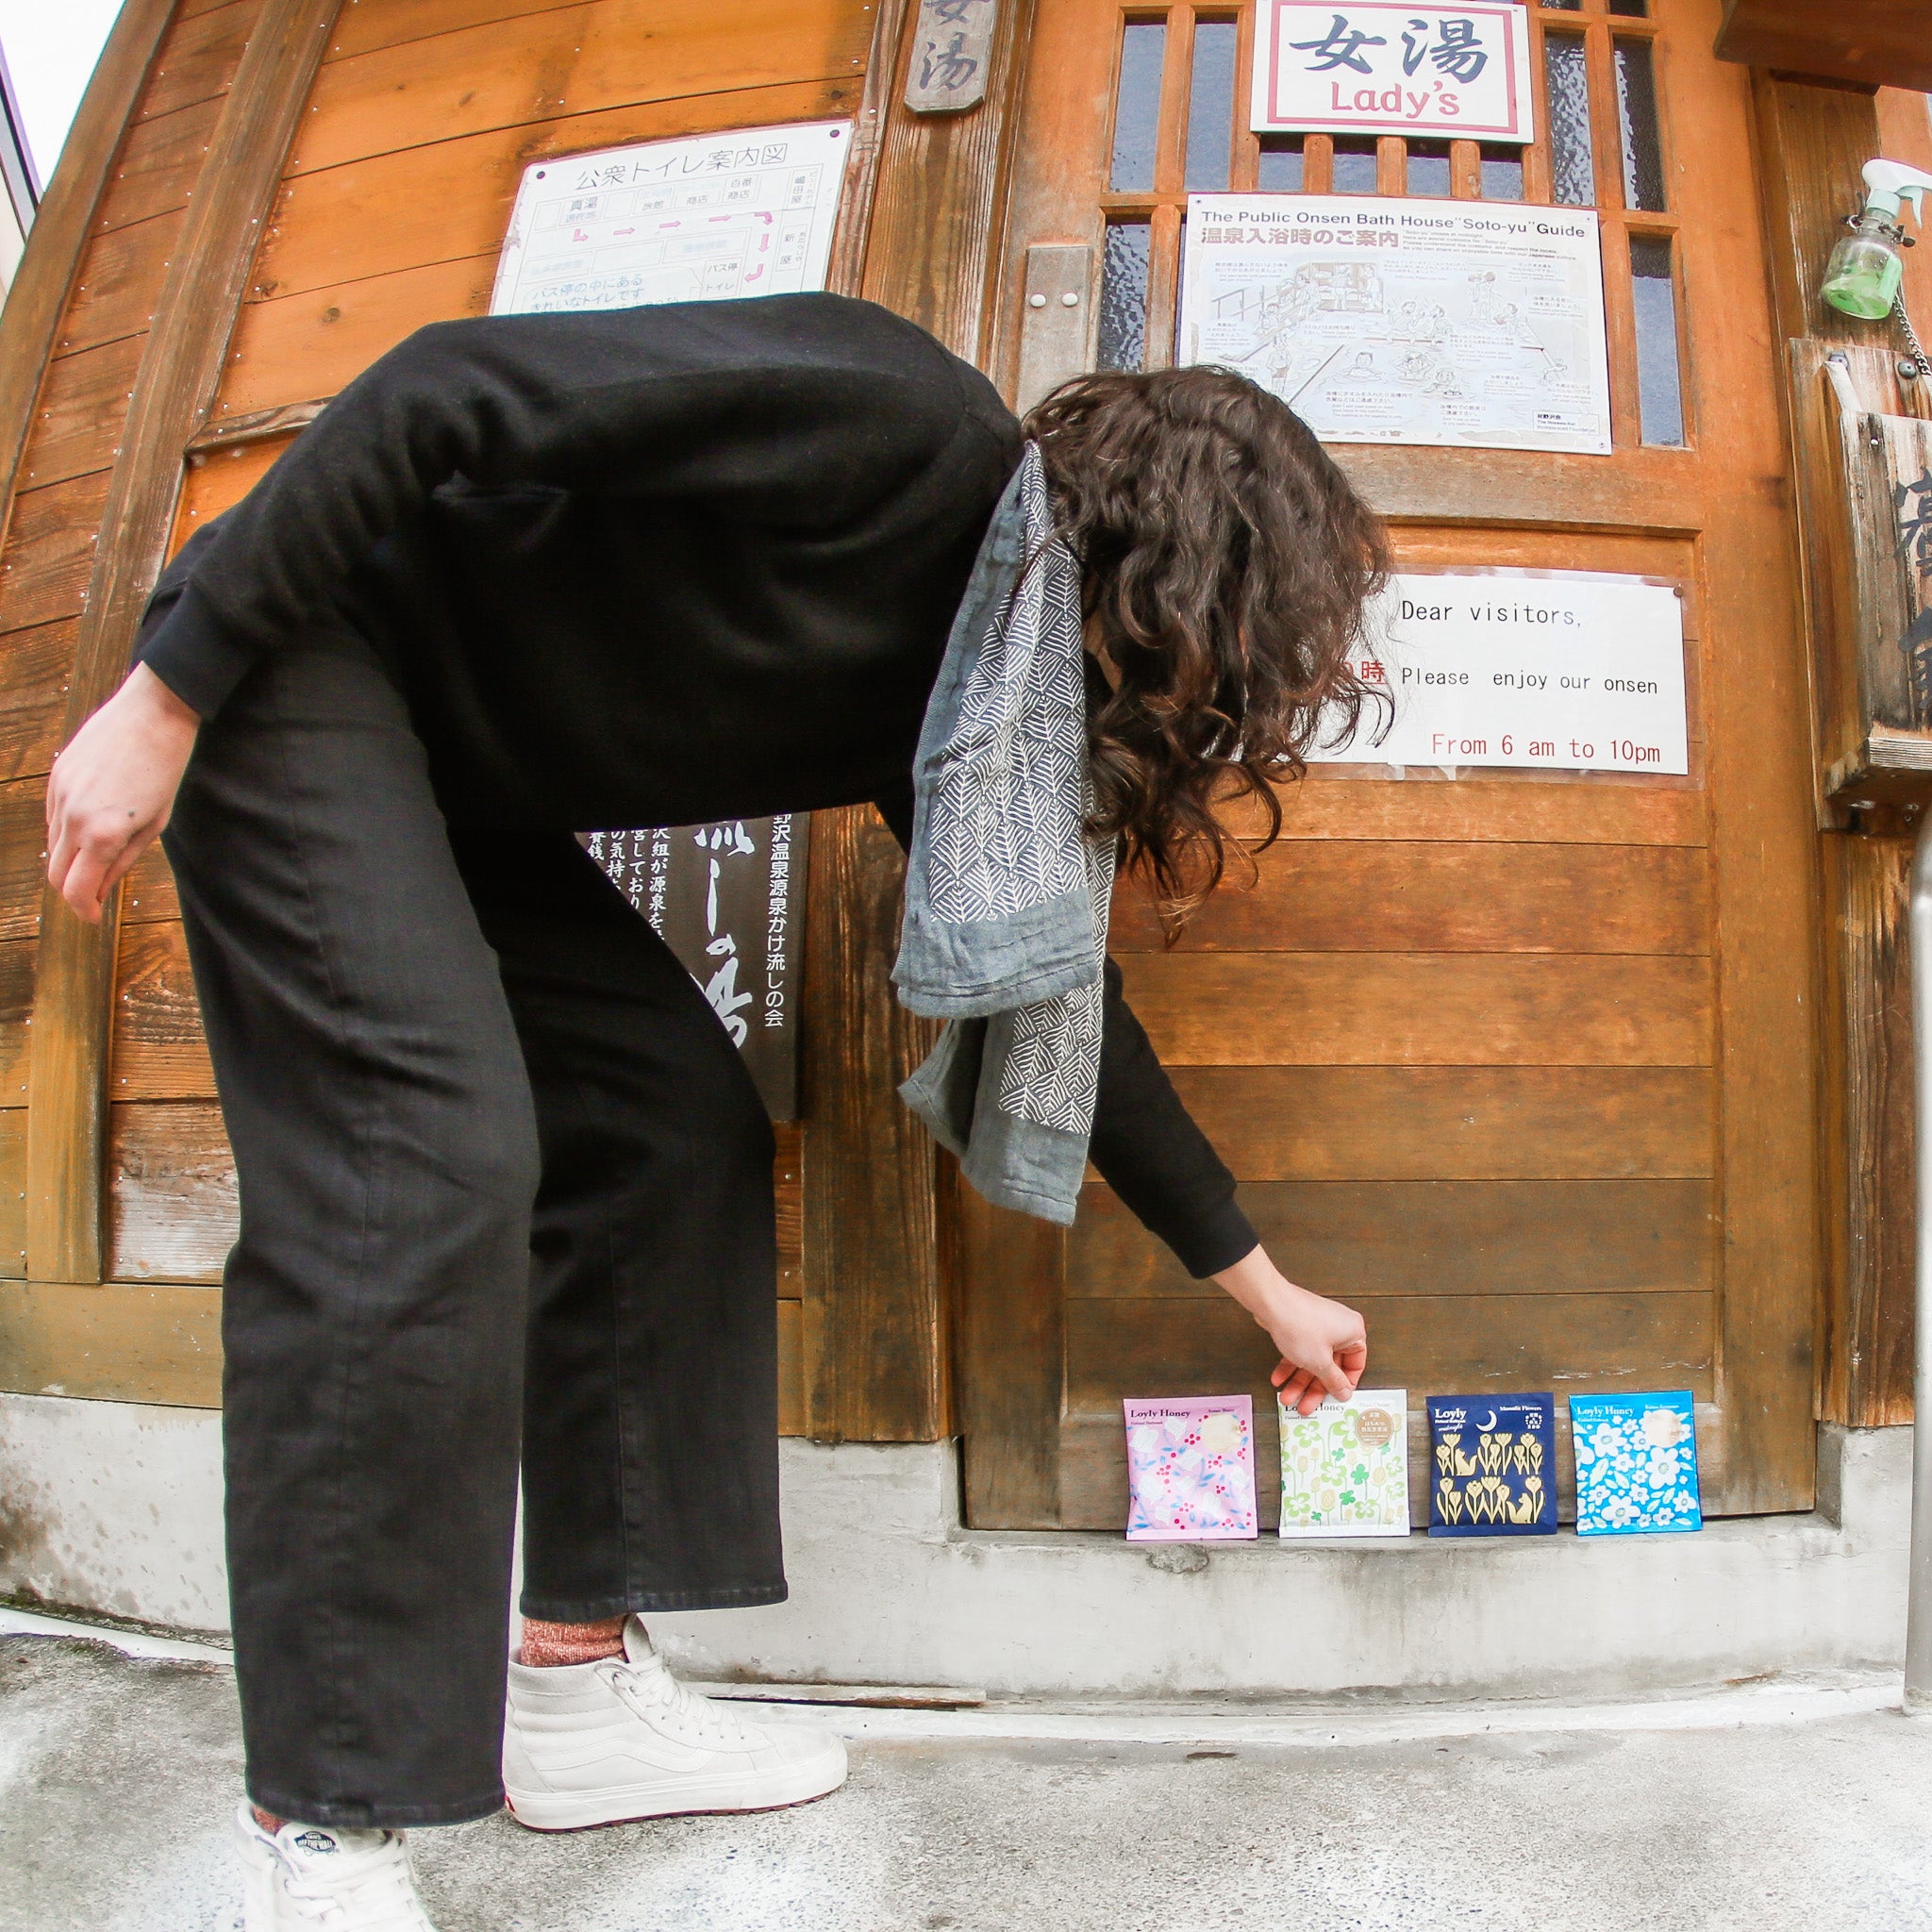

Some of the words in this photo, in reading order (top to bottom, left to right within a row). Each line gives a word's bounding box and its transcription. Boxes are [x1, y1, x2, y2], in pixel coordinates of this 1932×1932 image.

[1289, 14, 1489, 84] 女湯
[1331, 80, 1459, 119] Lady's
[575, 143, 788, 191] 公衆トイレ案内図
[1201, 211, 1233, 223] The
[1239, 211, 1291, 224] Public
[1296, 211, 1350, 225] Onsen
[1357, 213, 1394, 225] Bath
[1537, 223, 1585, 238] Guide
[1201, 227, 1400, 248] 温泉入浴時のご案内
[1402, 600, 1453, 621] Dear
[1470, 602, 1582, 628] visitors,
[1402, 667, 1469, 686] Please
[1493, 669, 1548, 690] enjoy
[1559, 675, 1591, 690] our
[1604, 678, 1658, 694] onsen
[1432, 734, 1487, 755] From
[1501, 735, 1513, 755] 6
[1529, 741, 1555, 757] am
[1570, 738, 1594, 758] to
[1610, 740, 1661, 764] 10pm
[1130, 1409, 1158, 1419] Loyly
[1159, 1408, 1191, 1419] Honey
[1435, 1407, 1467, 1420] Loyly
[1577, 1406, 1603, 1417] Loyly
[1605, 1406, 1634, 1417] Honey
